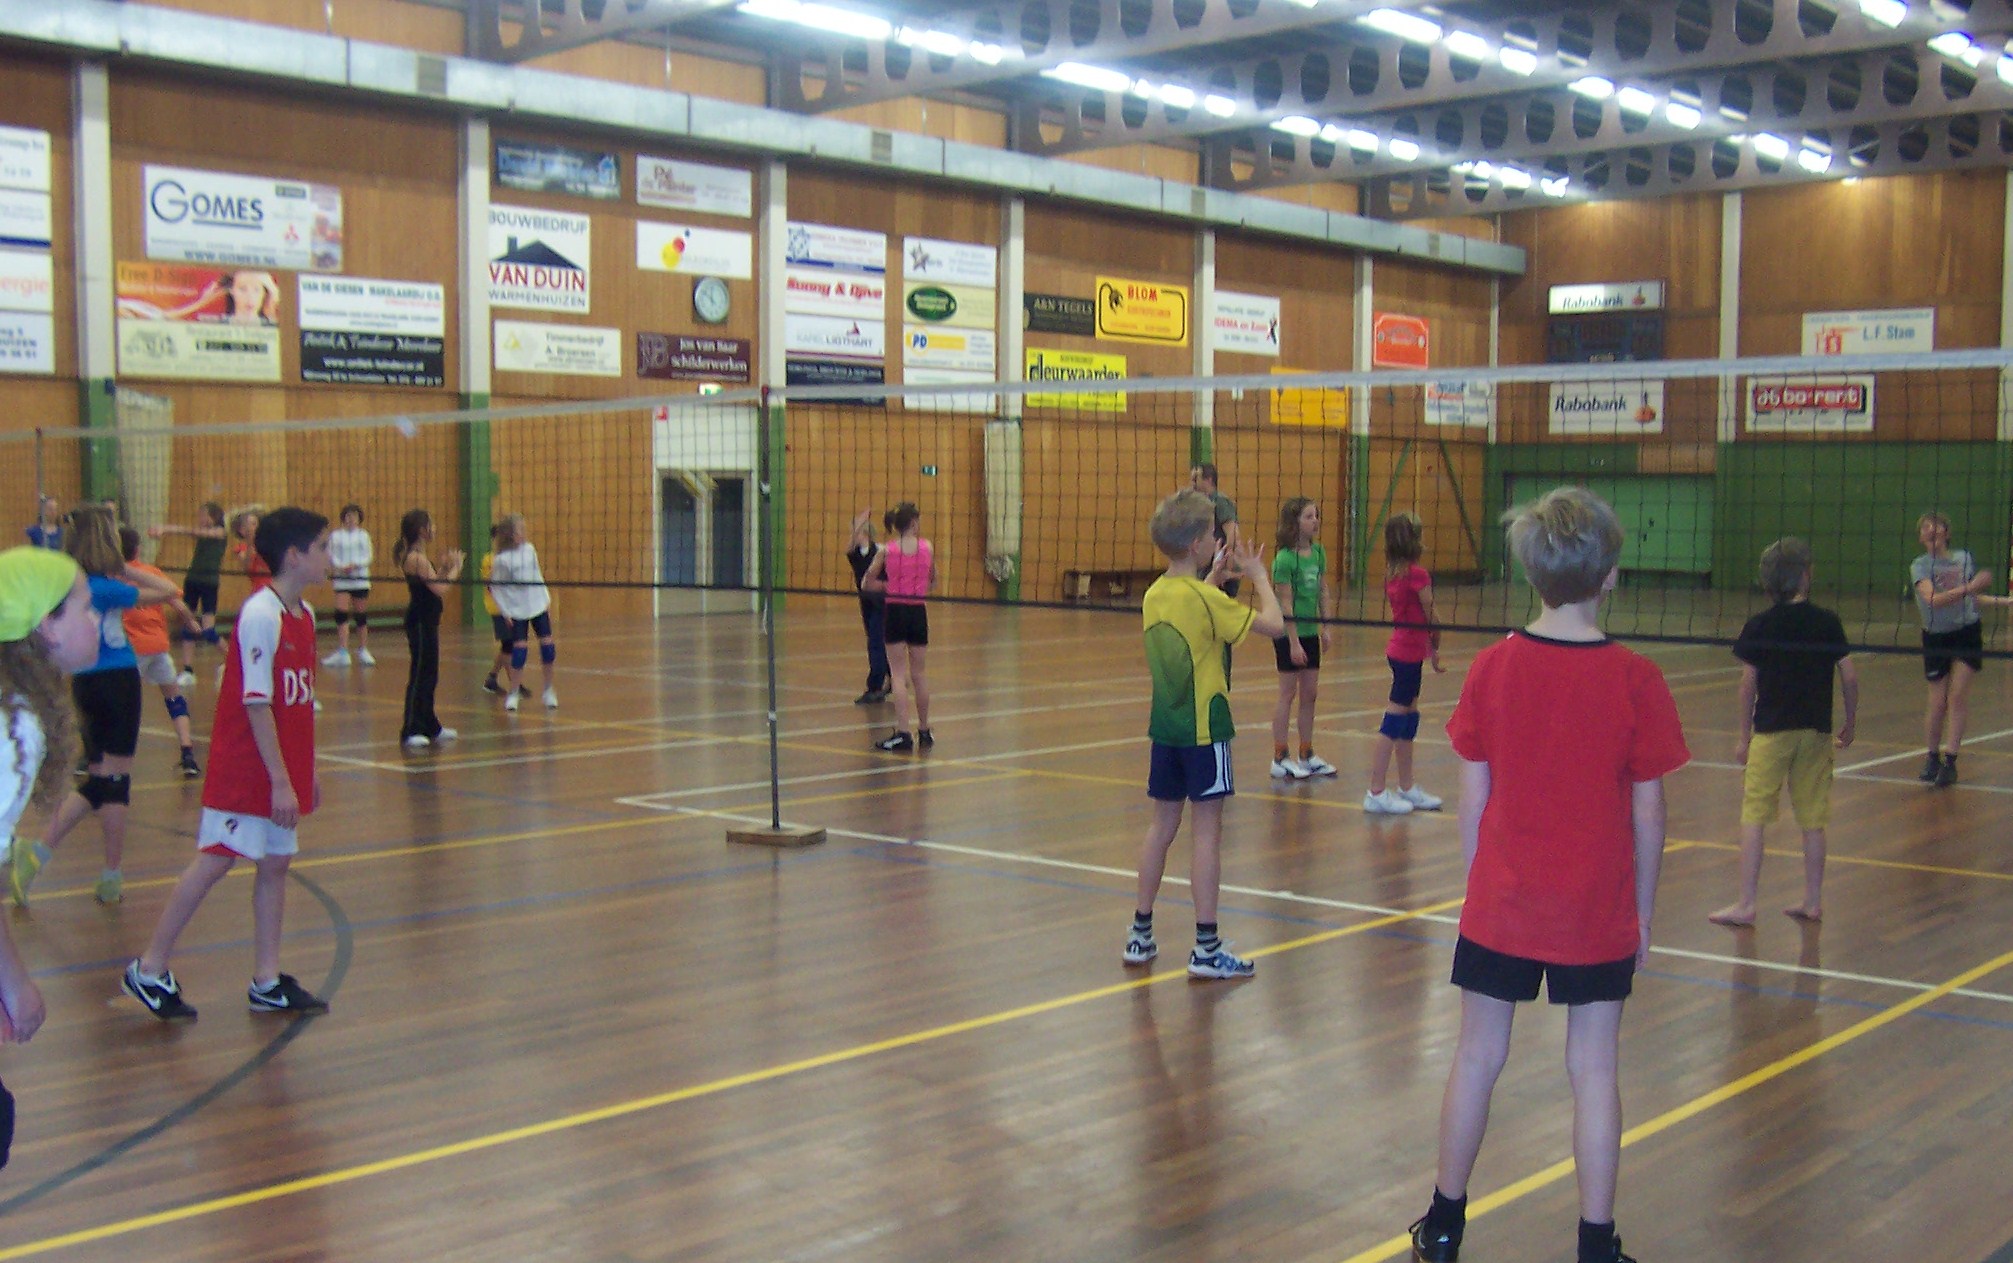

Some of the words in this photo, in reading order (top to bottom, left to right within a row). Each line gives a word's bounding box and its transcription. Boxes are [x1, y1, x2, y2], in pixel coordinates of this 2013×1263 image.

[150, 179, 265, 224] GOMES
[489, 262, 529, 287] VAN
[534, 266, 585, 292] DUIN
[1127, 285, 1158, 303] BLOM
[1562, 293, 1623, 309] Rabobank
[1555, 395, 1627, 412] Rabobank
